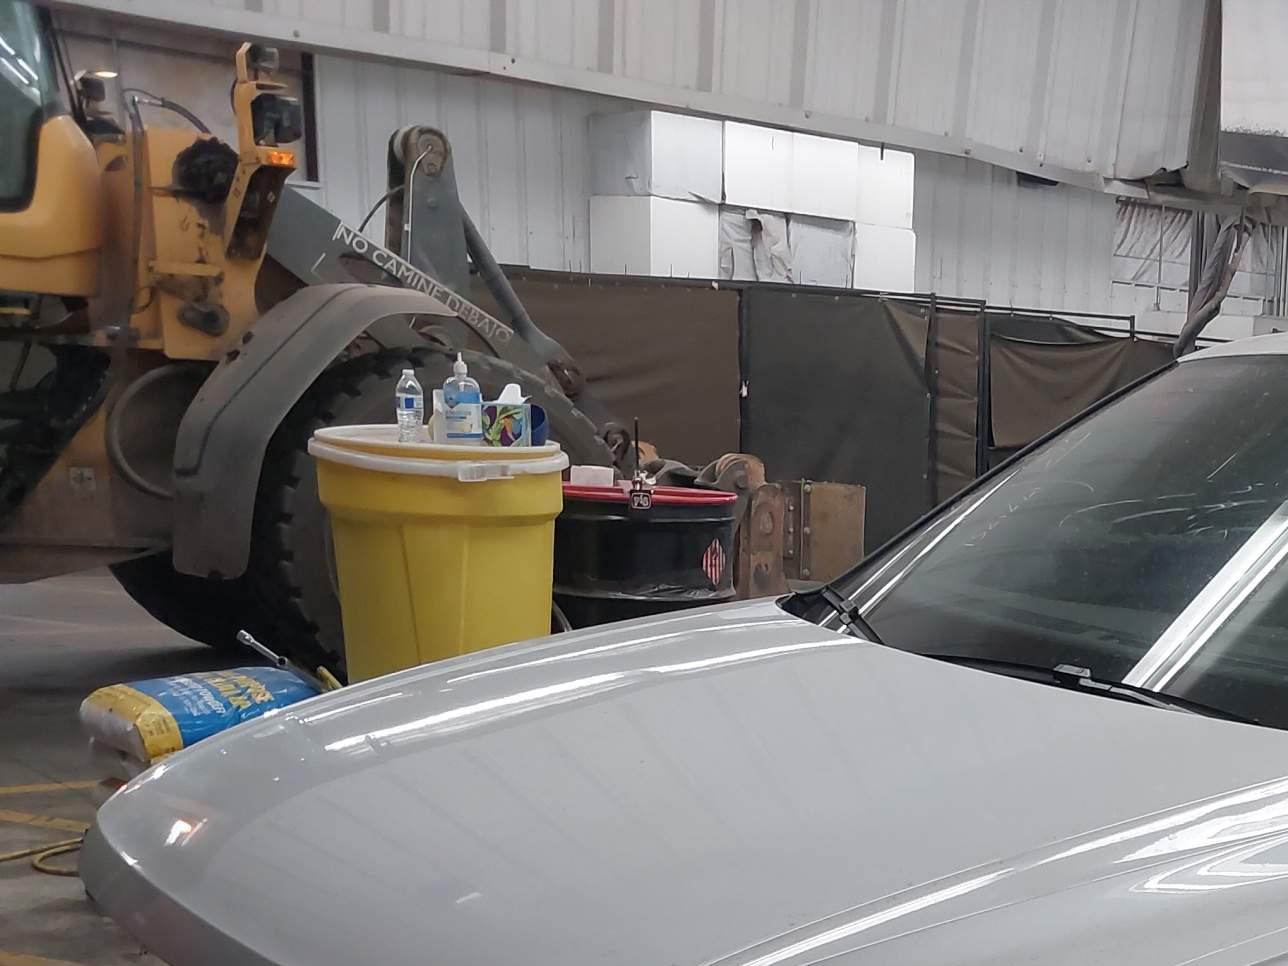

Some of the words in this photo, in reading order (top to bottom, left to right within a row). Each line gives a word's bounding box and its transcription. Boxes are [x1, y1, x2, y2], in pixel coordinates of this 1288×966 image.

[337, 225, 368, 254] NO
[371, 250, 446, 300] CAMINE
[446, 295, 513, 343] DEBAJO
